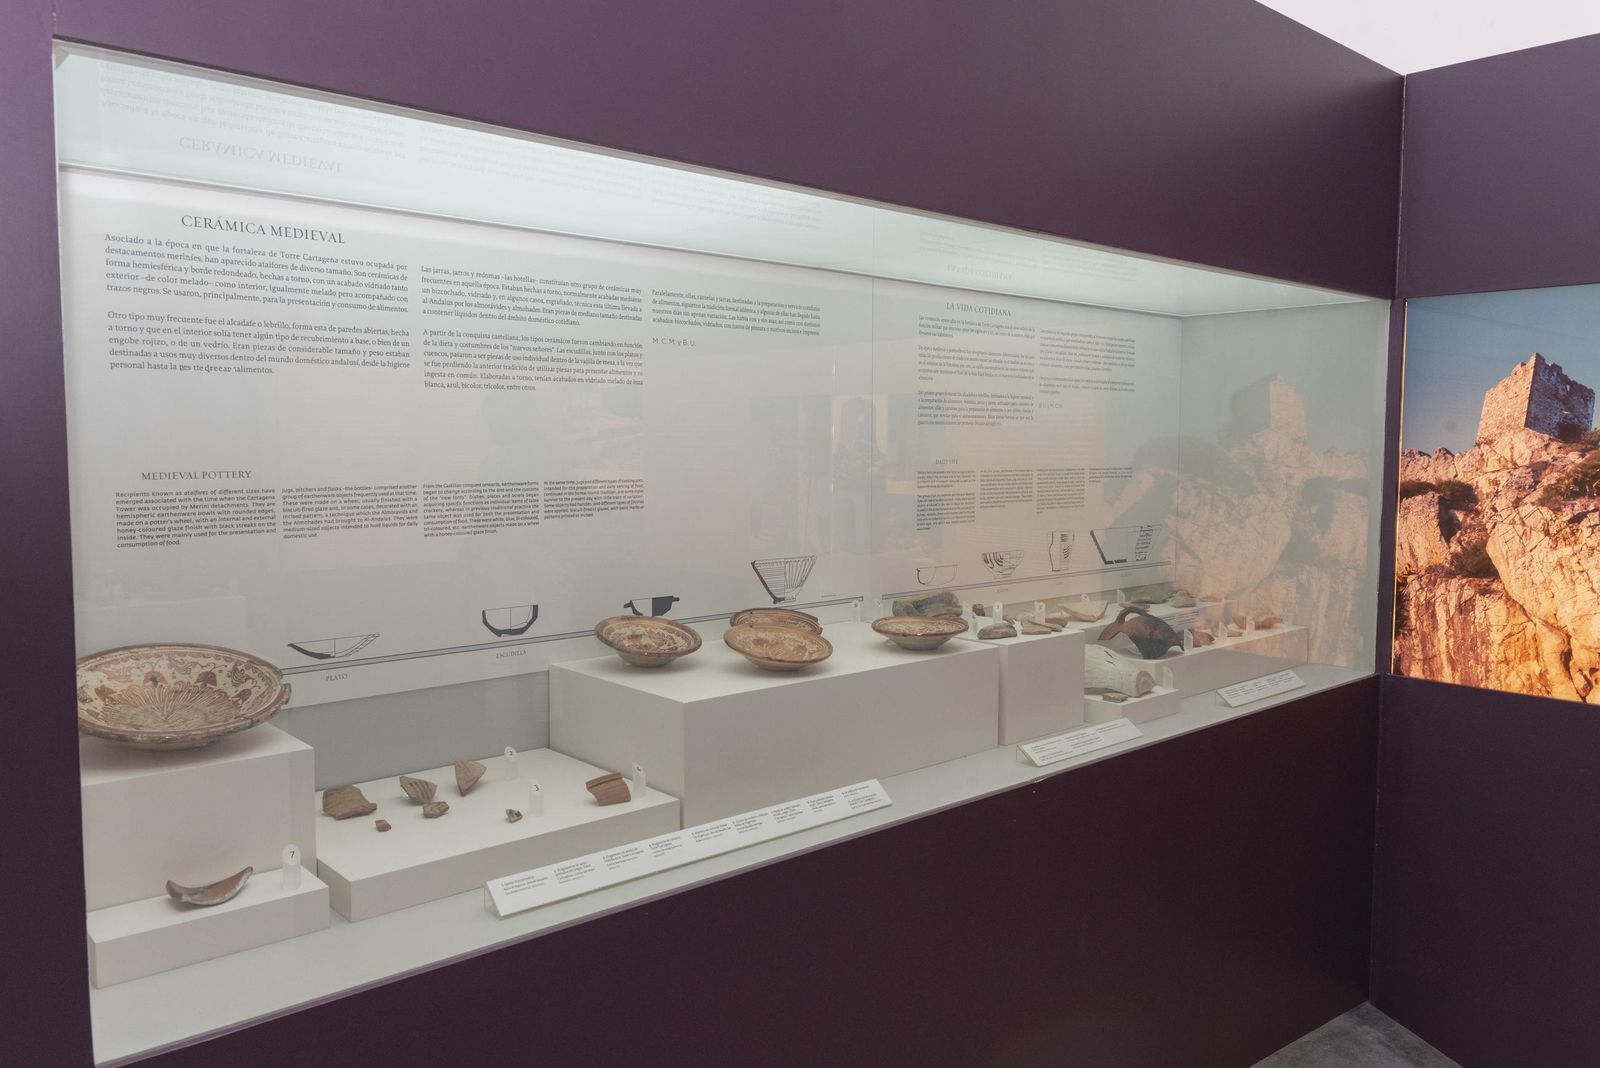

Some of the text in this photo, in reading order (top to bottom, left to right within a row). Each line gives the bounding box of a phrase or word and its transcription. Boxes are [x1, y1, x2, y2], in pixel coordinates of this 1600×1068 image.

[182, 215, 345, 244] CERÁMICA MEDIEVAL
[105, 233, 144, 244] Asociado
[165, 239, 189, 249] época
[232, 246, 266, 256] fortaleza
[280, 251, 300, 260] Torre
[302, 253, 339, 264] Cartagena
[365, 261, 394, 270] ocupada
[105, 246, 166, 258] destacamentos
[204, 255, 219, 263] han
[220, 258, 257, 267] aparecido
[299, 264, 325, 273] diverso
[354, 269, 367, 277] Son
[105, 258, 131, 267] forma
[132, 260, 183, 272] hemiesférica
[190, 266, 212, 274] borde
[213, 268, 258, 279] redondeado,
[290, 275, 312, 284] torno,
[336, 279, 364, 288] acabado
[364, 281, 391, 290] vidriado
[203, 291, 261, 303] principalmente,
[237, 281, 268, 292] interior,
[269, 284, 310, 294] igualmente
[311, 288, 337, 296] melado
[956, 303, 974, 312] VIDA
[974, 305, 1012, 316] COTIDIANA
[107, 311, 127, 319] Otro
[128, 312, 145, 321] tipo
[166, 314, 203, 324] frecuente
[226, 318, 256, 327] alcadafe
[263, 320, 291, 330] lebrillo,
[292, 322, 313, 330] forma
[337, 326, 362, 334] paredes
[390, 328, 409, 336] hecha
[108, 337, 140, 345] engobe
[142, 338, 168, 347] rojizo,
[252, 343, 276, 352] piezas
[288, 345, 333, 354] considerable
[142, 470, 251, 480] MEDIEVAL POTTERY
[290, 850, 295, 859] 7
